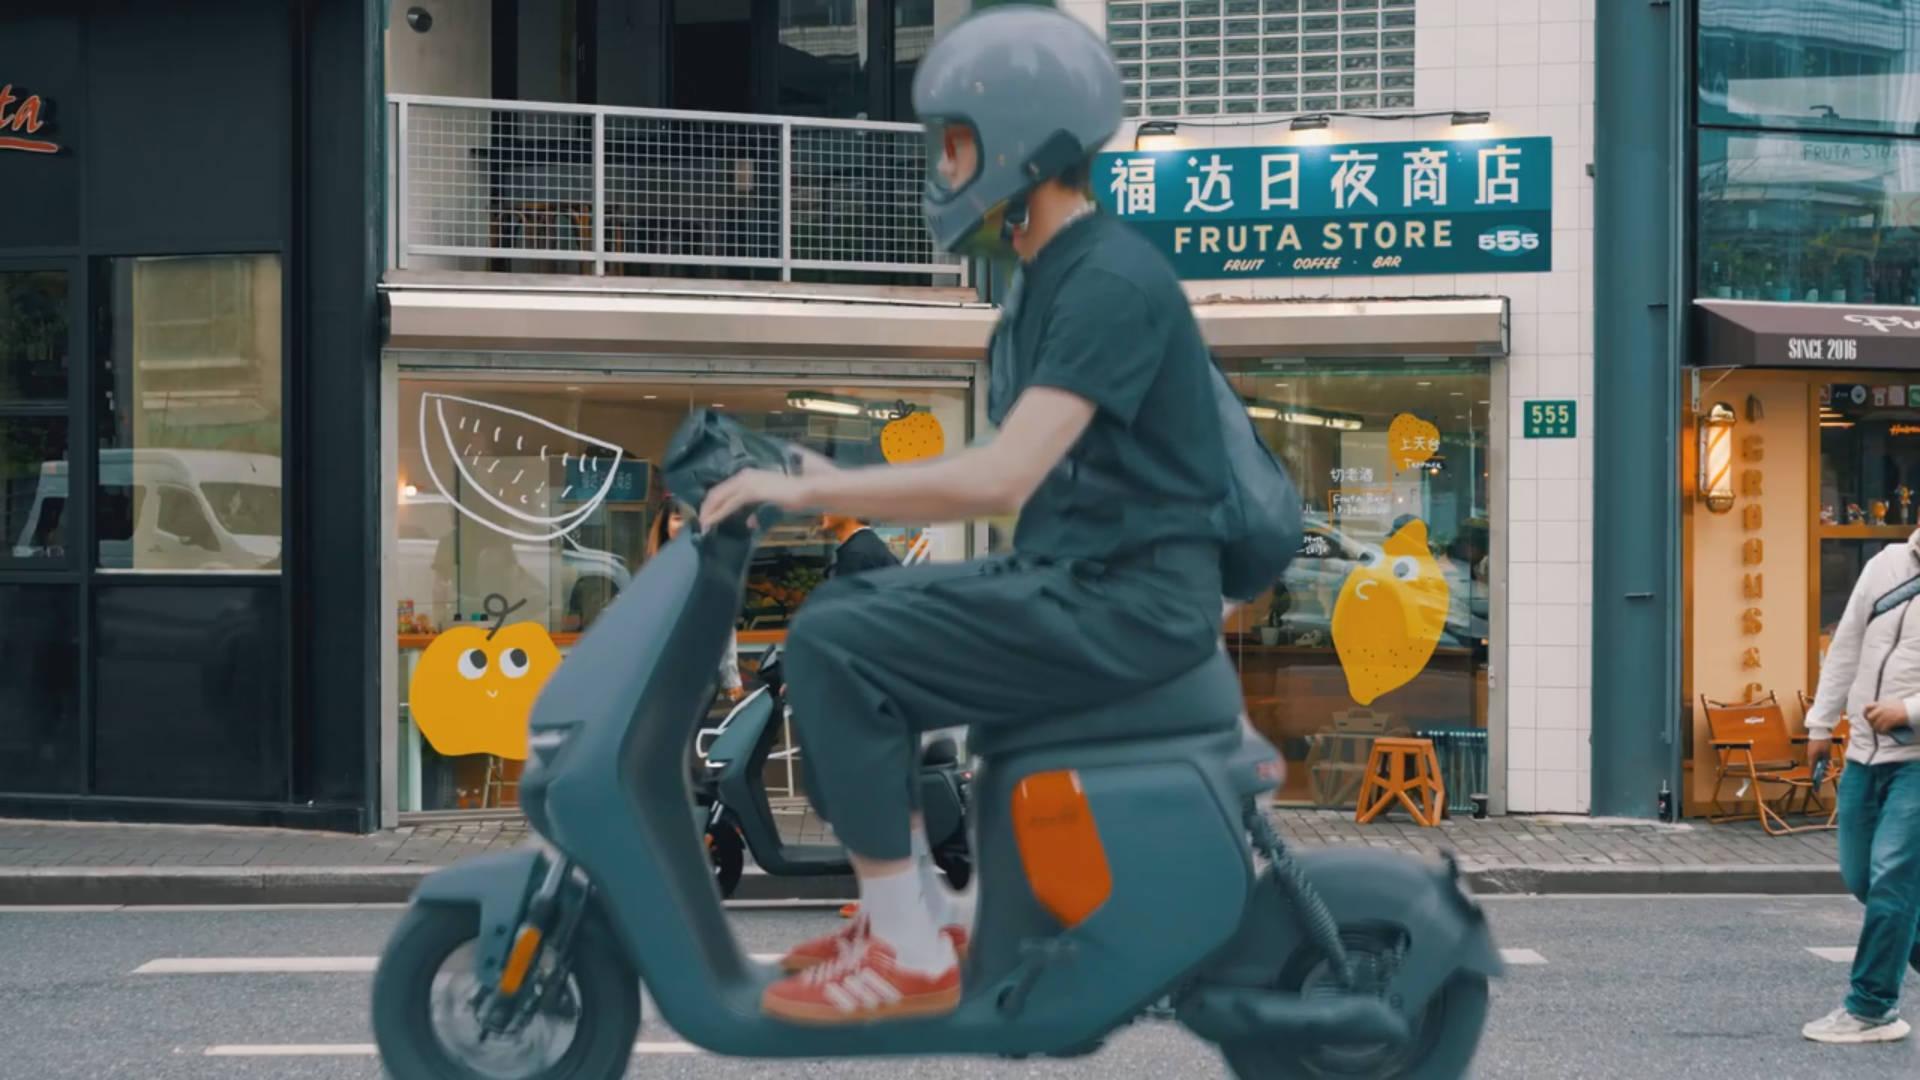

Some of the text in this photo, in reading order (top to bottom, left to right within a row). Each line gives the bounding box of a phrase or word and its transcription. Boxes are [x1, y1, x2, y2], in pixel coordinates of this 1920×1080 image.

[1110, 144, 1522, 216] 福达日夜商店
[1175, 220, 1453, 254] FRUTA STORE
[1478, 229, 1540, 252] 555
[1223, 255, 1402, 272] FRUIT COFFEE BAR
[1787, 337, 1858, 361] SINCE 2016
[1531, 404, 1570, 425] 555
[1400, 435, 1441, 452] 上天台
